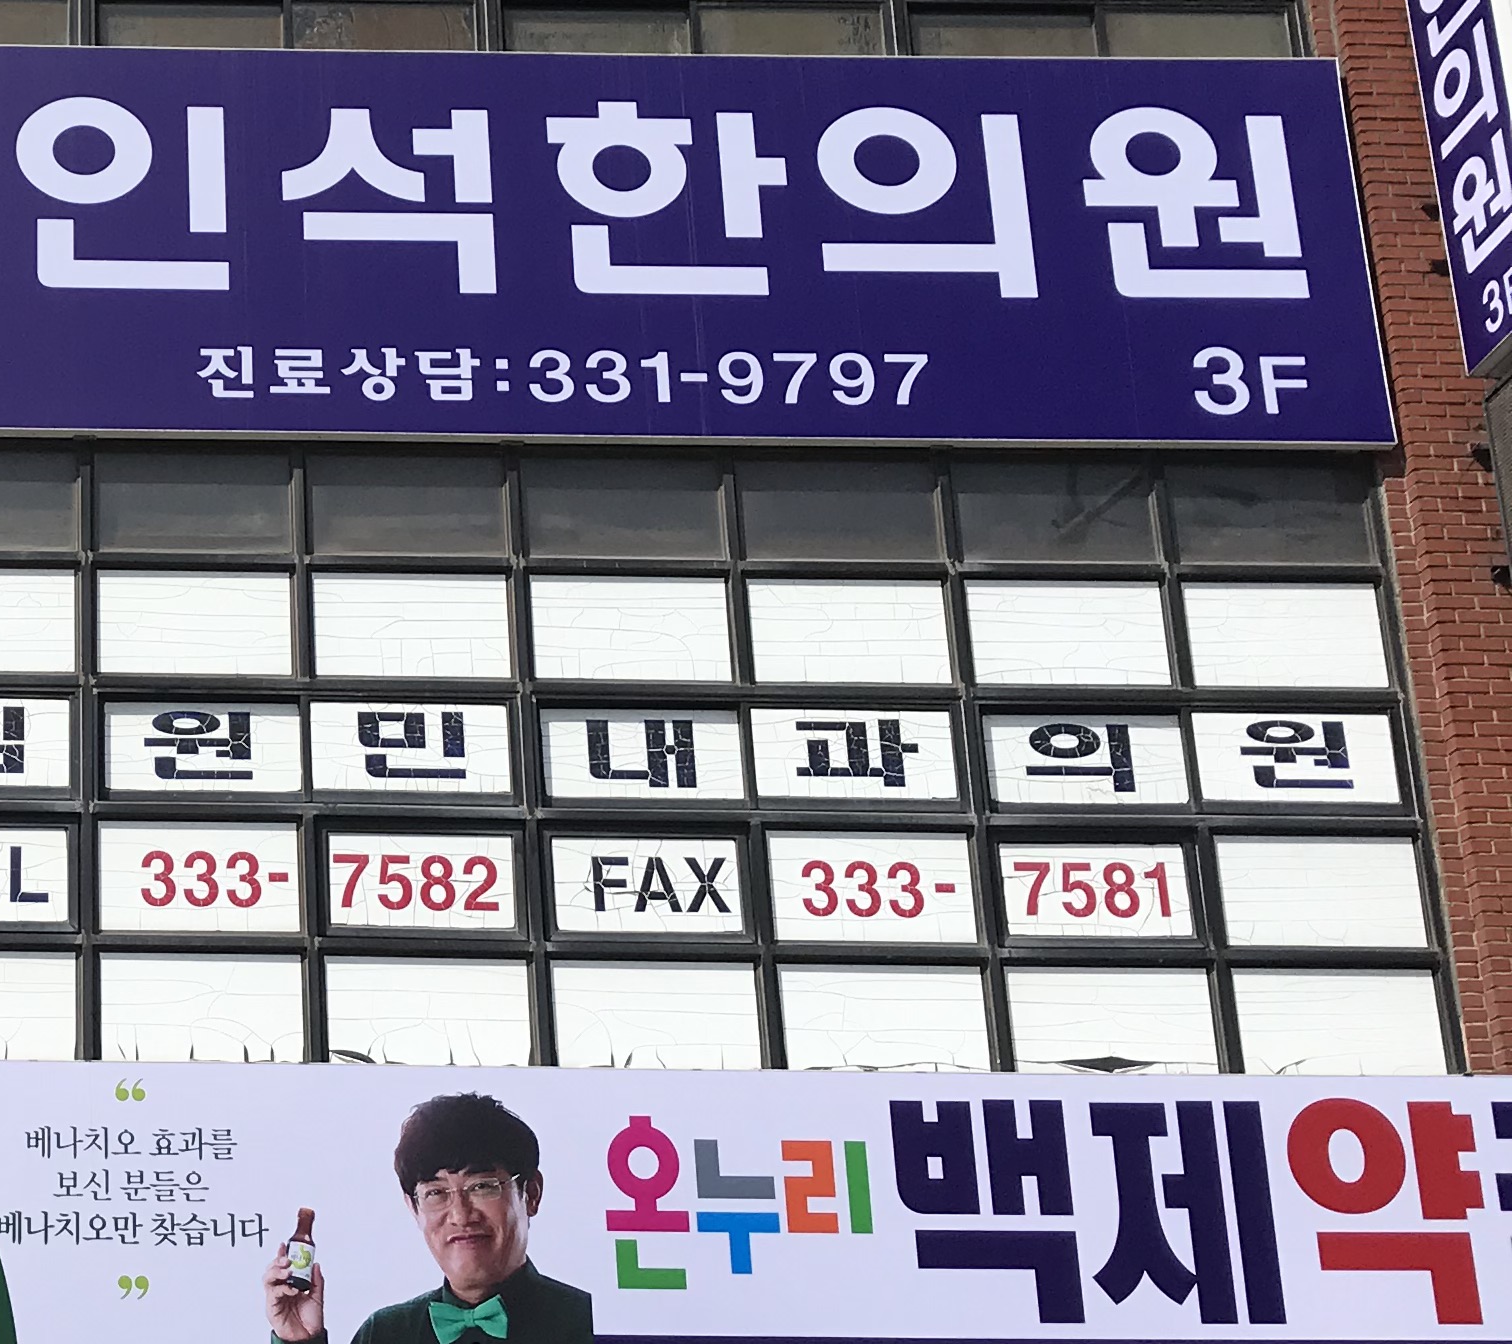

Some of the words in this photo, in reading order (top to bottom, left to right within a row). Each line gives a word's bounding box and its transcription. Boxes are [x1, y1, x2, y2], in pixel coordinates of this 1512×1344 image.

[1190, 345, 1309, 416] 3F
[589, 855, 733, 915] FAX
[24, 1125, 143, 1160] 베나치오
[148, 1125, 239, 1162] 효과를
[52, 1169, 113, 1203] 보신
[120, 1169, 211, 1204] 분들은
[149, 1211, 271, 1249] 찾습니다
[605, 1114, 874, 1291] 온누리
[888, 1097, 1512, 1326] 백제약
